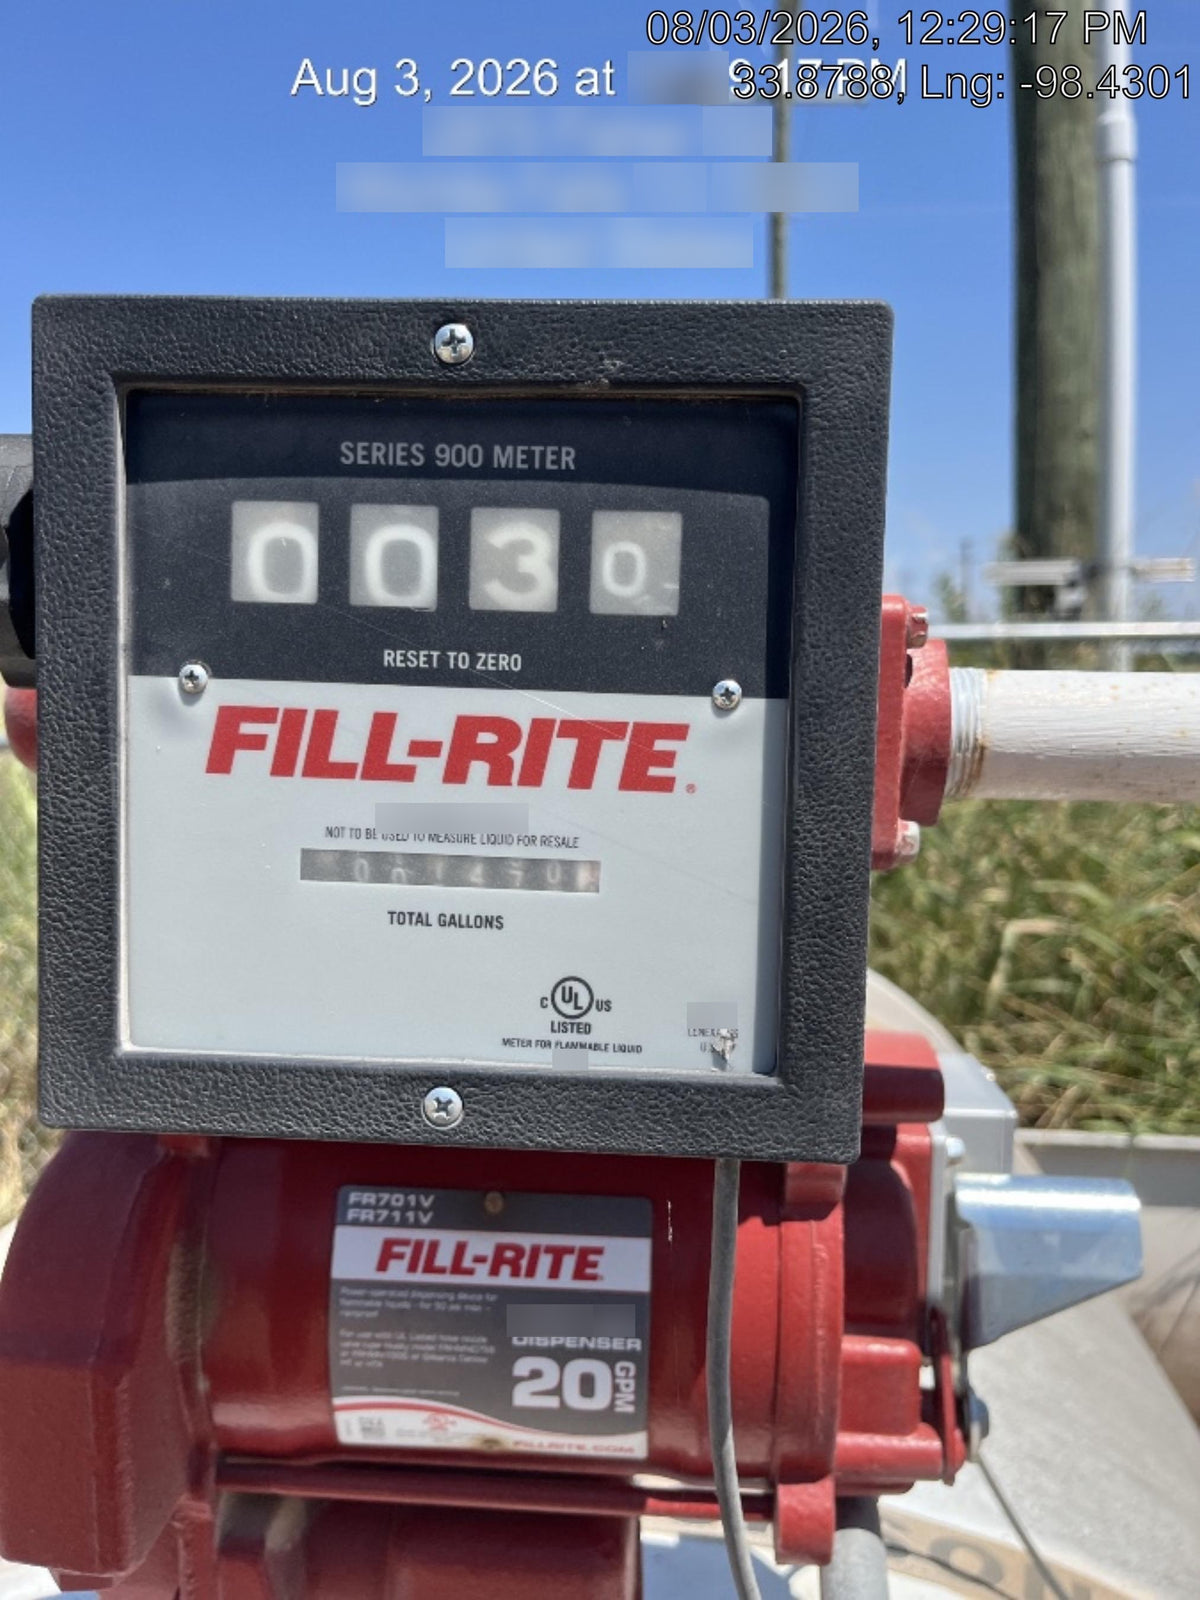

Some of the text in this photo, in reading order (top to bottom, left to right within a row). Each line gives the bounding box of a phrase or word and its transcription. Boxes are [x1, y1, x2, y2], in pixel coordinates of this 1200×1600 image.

[340, 440, 577, 471] SERIES 900 METER
[383, 649, 523, 672] RESET TO ZERO
[205, 704, 691, 793] FILL-RITE
[325, 825, 346, 839] NOT
[349, 827, 362, 840] TO
[480, 832, 514, 846] LIQUID
[517, 834, 538, 847] FOR
[540, 834, 580, 849] RESALE
[387, 910, 505, 931] TOTAL GALLONS
[595, 999, 613, 1013] US
[550, 1020, 593, 1036] LISTED
[502, 1037, 643, 1055] METER FOR FLAMMABLE LIQUID
[348, 1191, 436, 1209] FR701V
[346, 1208, 434, 1225] FR711V
[375, 1237, 606, 1282] FILL-RITE
[511, 1355, 637, 1413] 20 GPM
